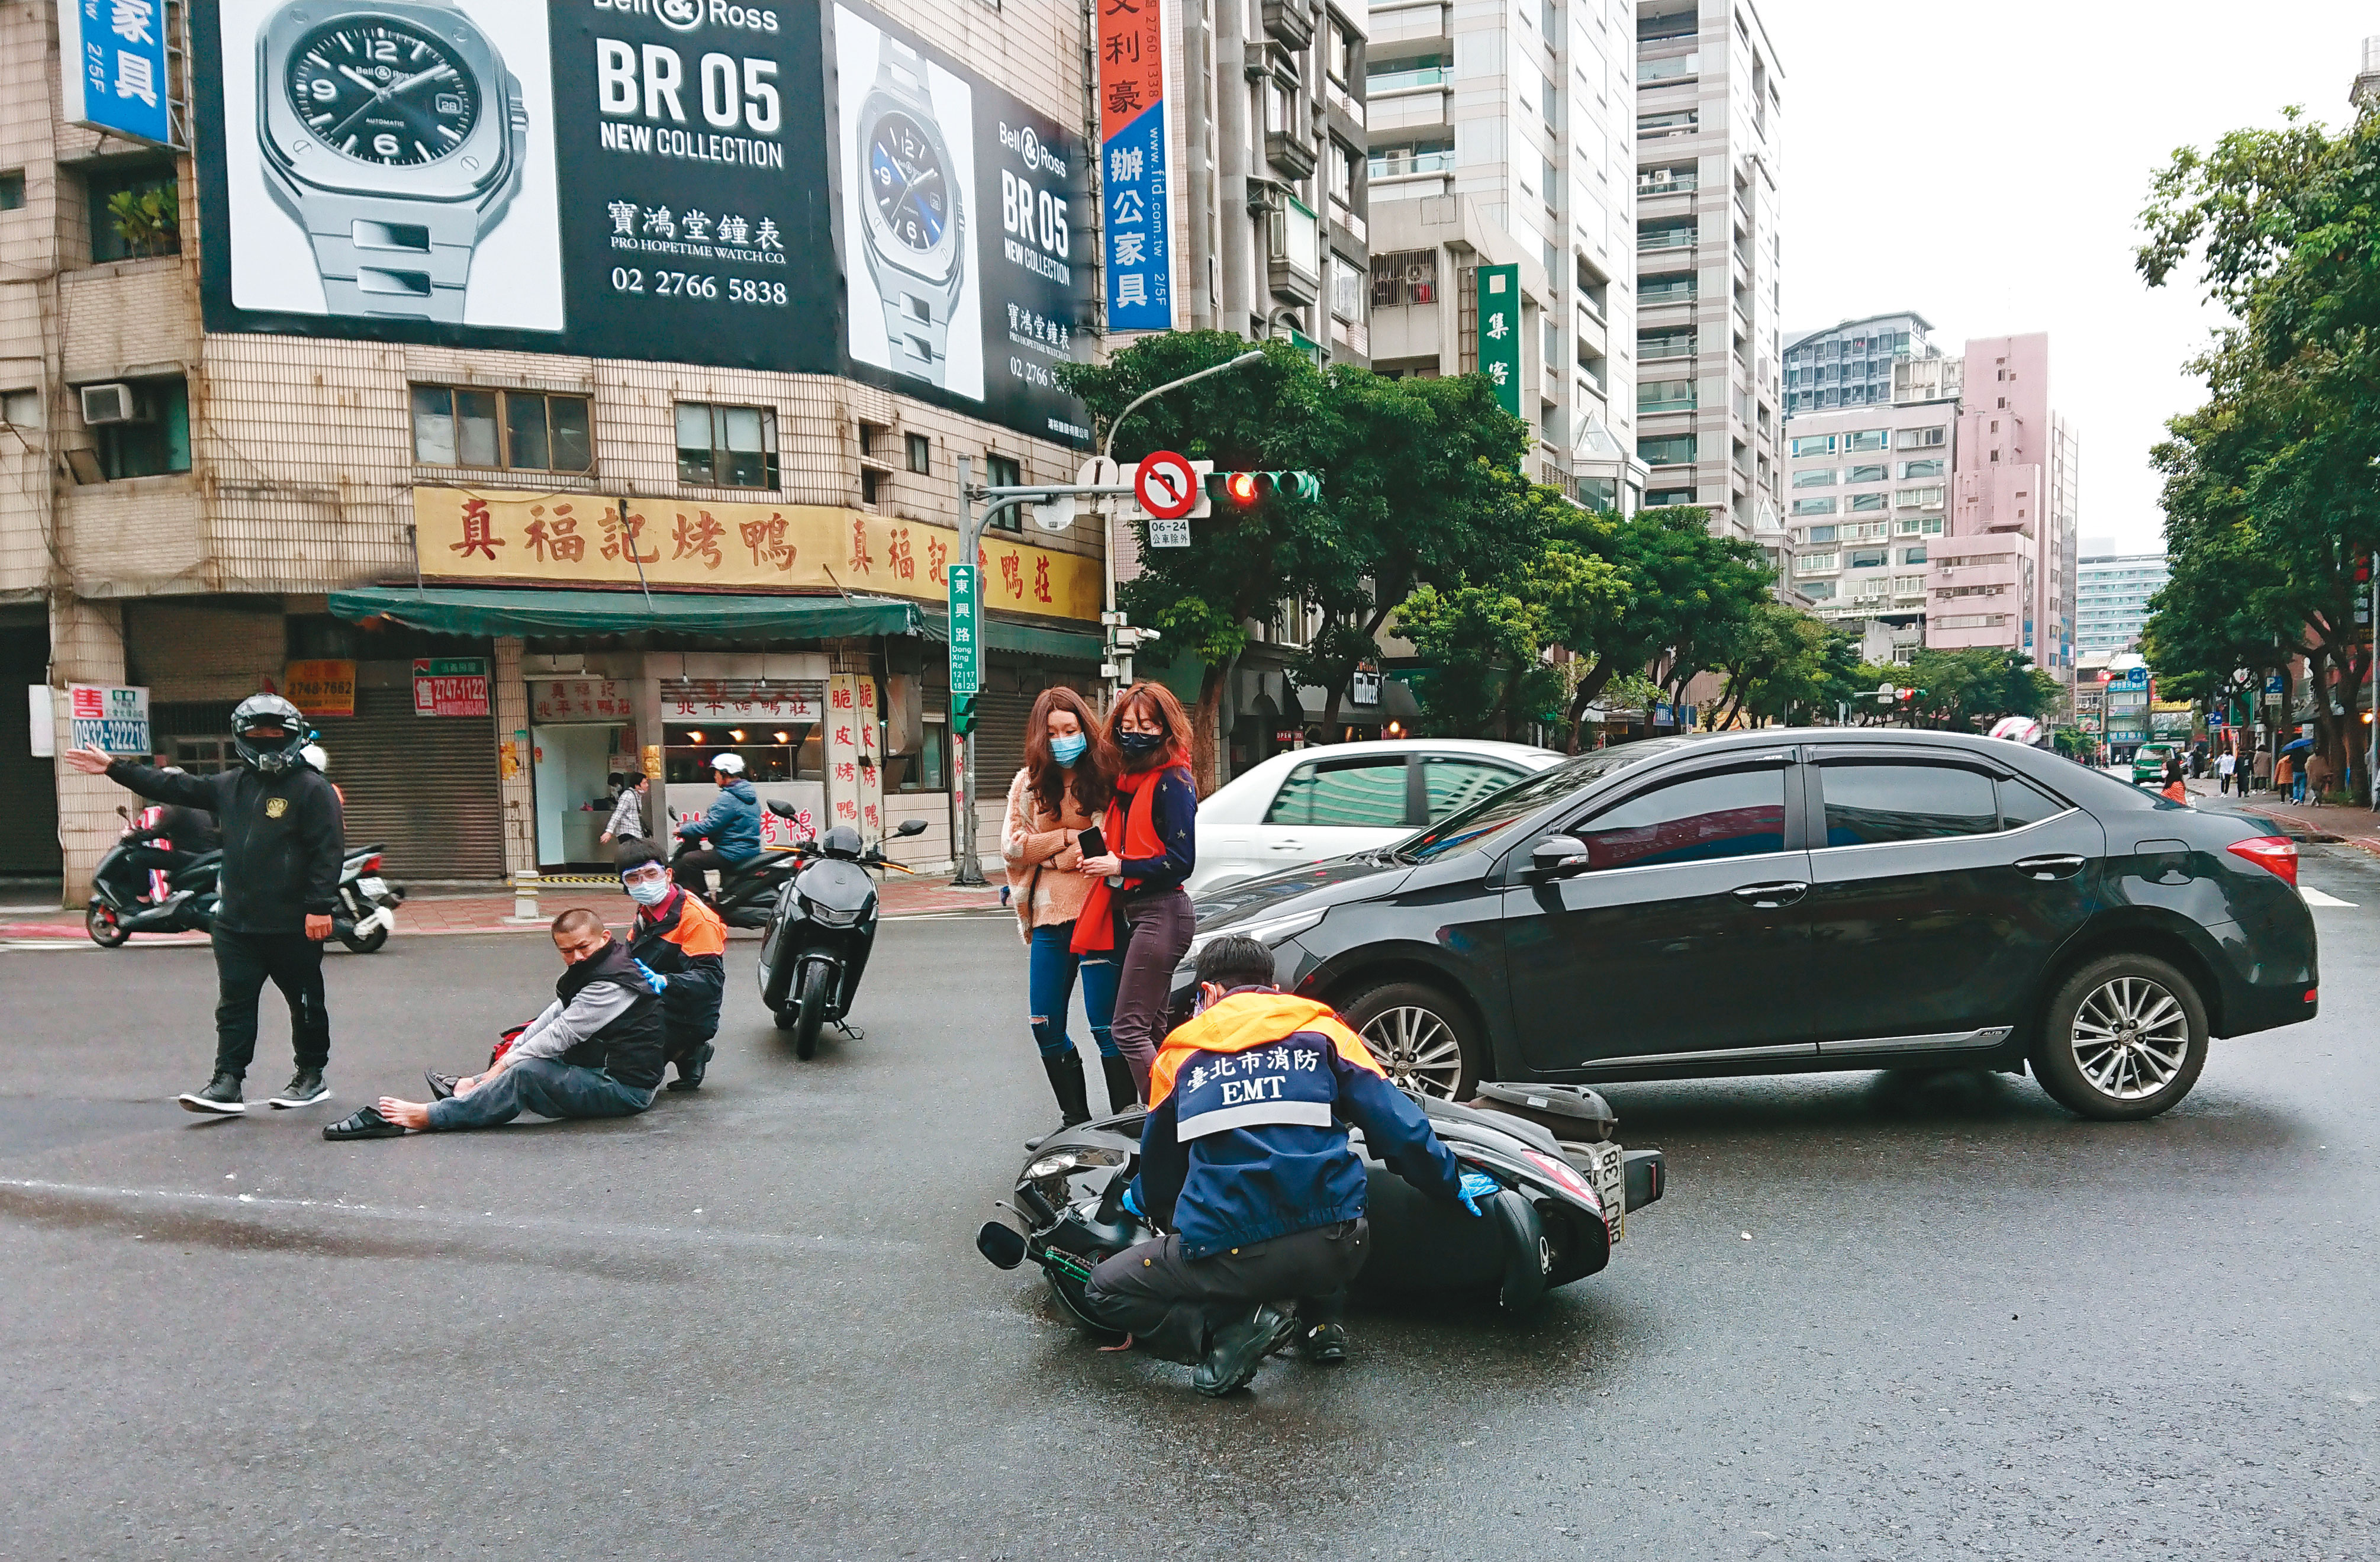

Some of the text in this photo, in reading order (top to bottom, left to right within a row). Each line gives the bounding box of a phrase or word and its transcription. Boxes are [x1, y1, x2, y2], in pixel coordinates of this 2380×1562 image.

[710, 0, 779, 31] Ross
[111, 0, 157, 108] 家具
[365, 38, 398, 60] 12
[1145, 16, 1159, 98] 2760-1338
[87, 41, 105, 93] 2/5F
[311, 79, 337, 100] 9
[597, 37, 781, 133] BR 05
[365, 118, 405, 127] AUTOMATIC
[373, 133, 401, 156] 6
[600, 121, 784, 169] NEW COLLECTION
[901, 136, 915, 159] 12
[999, 121, 1020, 152] Bell
[1041, 145, 1066, 178] Ross
[880, 166, 891, 185] 9
[607, 199, 785, 250] 寶鴻堂鐘表
[906, 221, 917, 239] 6
[1002, 169, 1068, 257] BR 05
[1111, 146, 1148, 308] 辦公家具
[1149, 127, 1167, 306] www.fid.com.tw 2/5F
[610, 236, 786, 265] PRO HOPETIME WATCH CO.
[1004, 237, 1070, 286] NEW COLLECTION
[611, 266, 788, 304] 02 2766 5838
[1007, 302, 1070, 350] 寶鴻堂鐘表
[1009, 330, 1020, 343] PRO
[1020, 336, 1046, 355] HOPETIME
[1046, 347, 1063, 360] WATCH
[1010, 356, 1023, 378] 02
[1026, 362, 1048, 387] 2766
[449, 498, 798, 571] 真福記烤鴨
[1152, 521, 1187, 532] 06-24
[1153, 533, 1188, 544] 公車除外
[954, 578, 971, 642] 東興路
[952, 645, 972, 654] Dong
[952, 653, 969, 662] Xing
[2267, 677, 2276, 687] P
[2210, 713, 2215, 721] P
[832, 688, 857, 820] 脆皮烤鴨
[859, 683, 879, 828] 脆皮烤鴨
[1187, 1046, 1320, 1093] 臺北市消防
[1220, 1075, 1286, 1106] EMT
